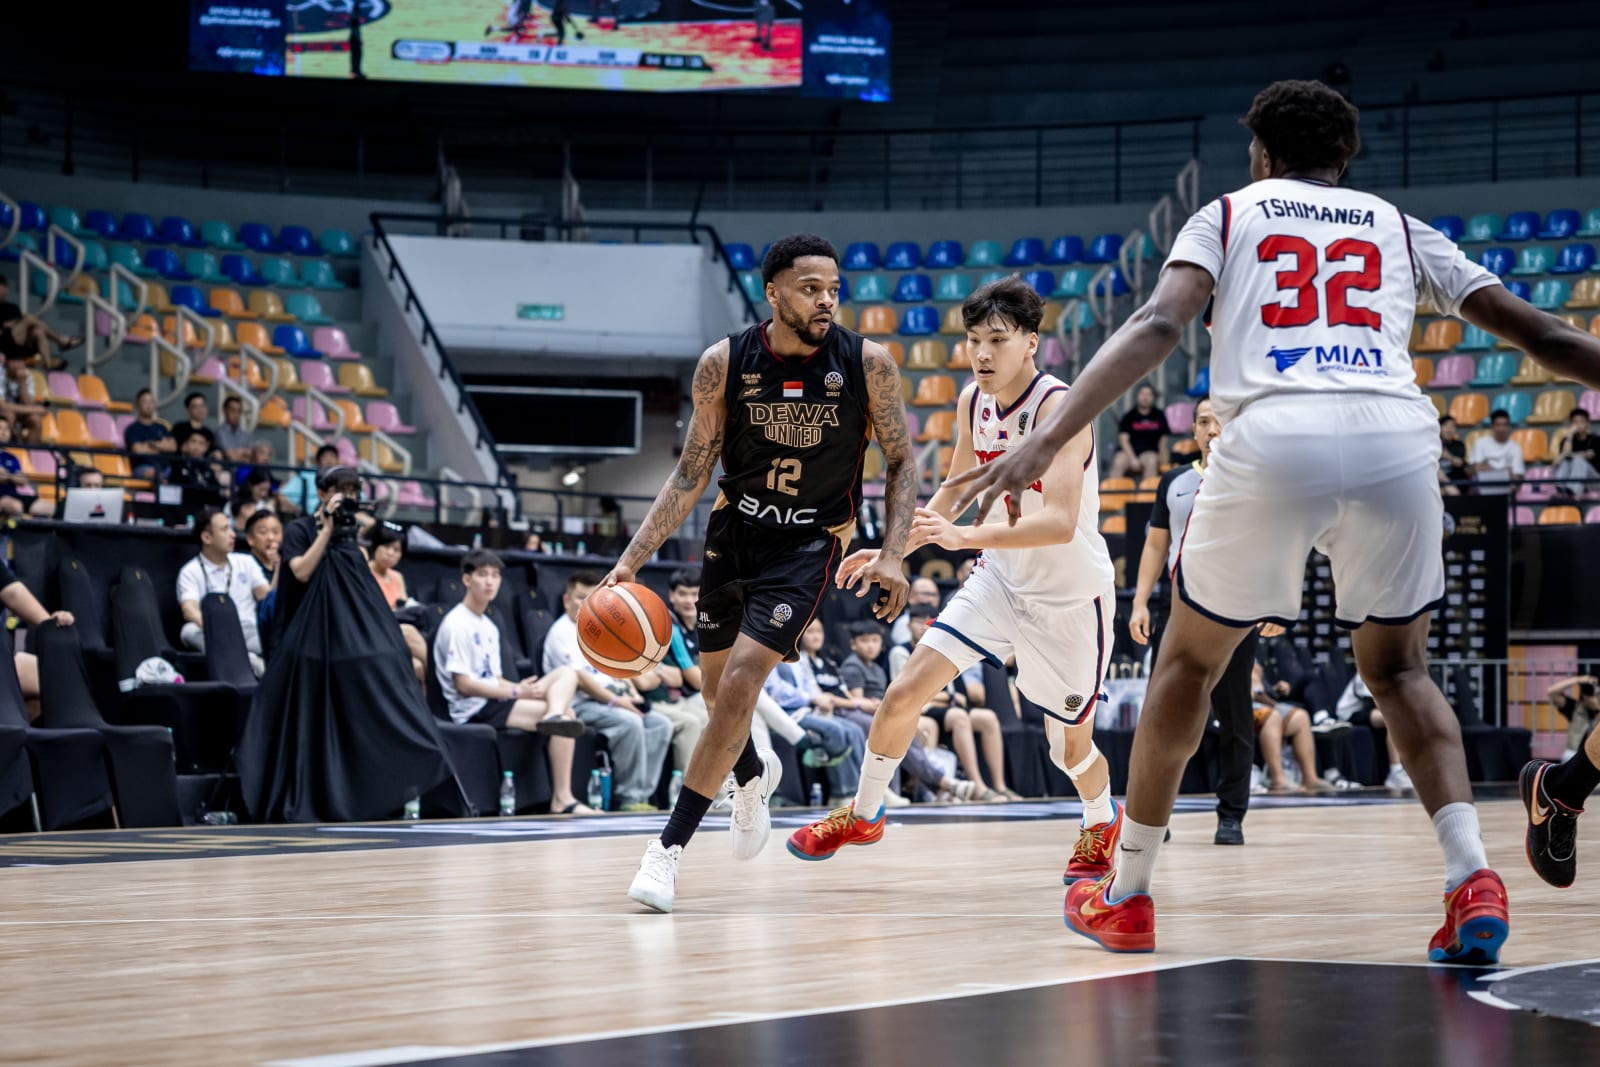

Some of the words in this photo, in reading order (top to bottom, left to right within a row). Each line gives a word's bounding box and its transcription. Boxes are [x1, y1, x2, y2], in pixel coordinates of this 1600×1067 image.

[1256, 198, 1375, 228] TSHIMANGA
[1256, 234, 1382, 332] 32
[1315, 344, 1384, 368] MIAT
[746, 402, 840, 427] DEWA
[764, 424, 822, 448] UNITED
[766, 457, 803, 497] 12
[737, 493, 818, 525] BAIC
[585, 619, 602, 639] FIBA
